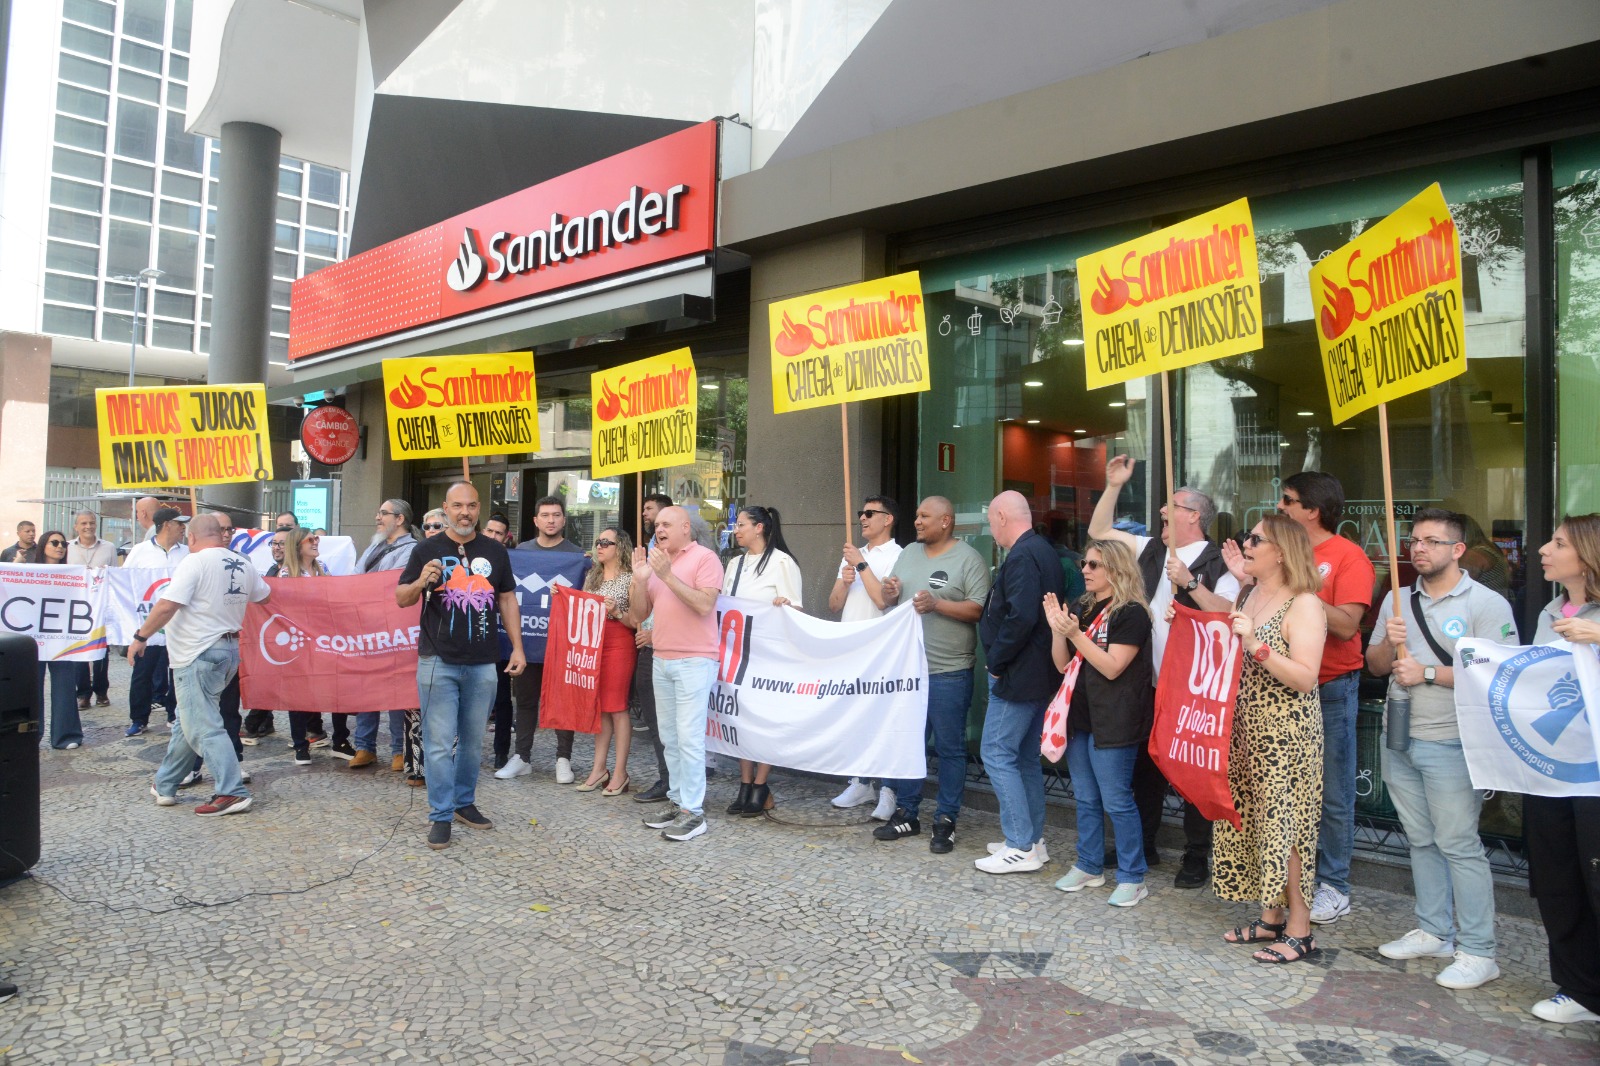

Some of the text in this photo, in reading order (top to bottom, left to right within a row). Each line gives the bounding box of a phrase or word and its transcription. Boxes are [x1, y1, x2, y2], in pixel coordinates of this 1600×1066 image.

[487, 183, 689, 281] Santander
[1121, 222, 1249, 307] Santander
[1346, 215, 1459, 322] Santander
[807, 289, 922, 350] Santander
[1095, 318, 1146, 374] CHEGA
[1158, 283, 1257, 357] DEMISSÕES
[785, 354, 834, 403] CHEGA
[844, 337, 923, 393] DEMISSÕES
[1327, 335, 1368, 409] CHEGA
[1370, 287, 1460, 389] DEMISSÕES
[420, 365, 534, 408] Santander
[618, 363, 693, 418] Santander
[106, 390, 257, 437] MENOS JUROS
[315, 420, 349, 431] CÂMBIO
[396, 414, 441, 452] CHEGA
[457, 405, 532, 449] DEMISSÕES
[315, 439, 350, 447] EXCHANGE
[597, 424, 629, 468] CHEGA
[637, 408, 693, 460] DEMISSÕES
[112, 439, 169, 485] MAIS
[1348, 504, 1419, 515] convesar
[0, 596, 94, 635] CEB
[564, 670, 596, 691] union
[566, 649, 598, 675] global
[1514, 655, 1530, 667] del
[707, 685, 740, 717] obal
[1491, 664, 1515, 722] Trabajadores
[1176, 704, 1226, 738] global
[1501, 723, 1513, 736] de
[1168, 736, 1220, 772] union
[1510, 737, 1556, 775] Sindicato
